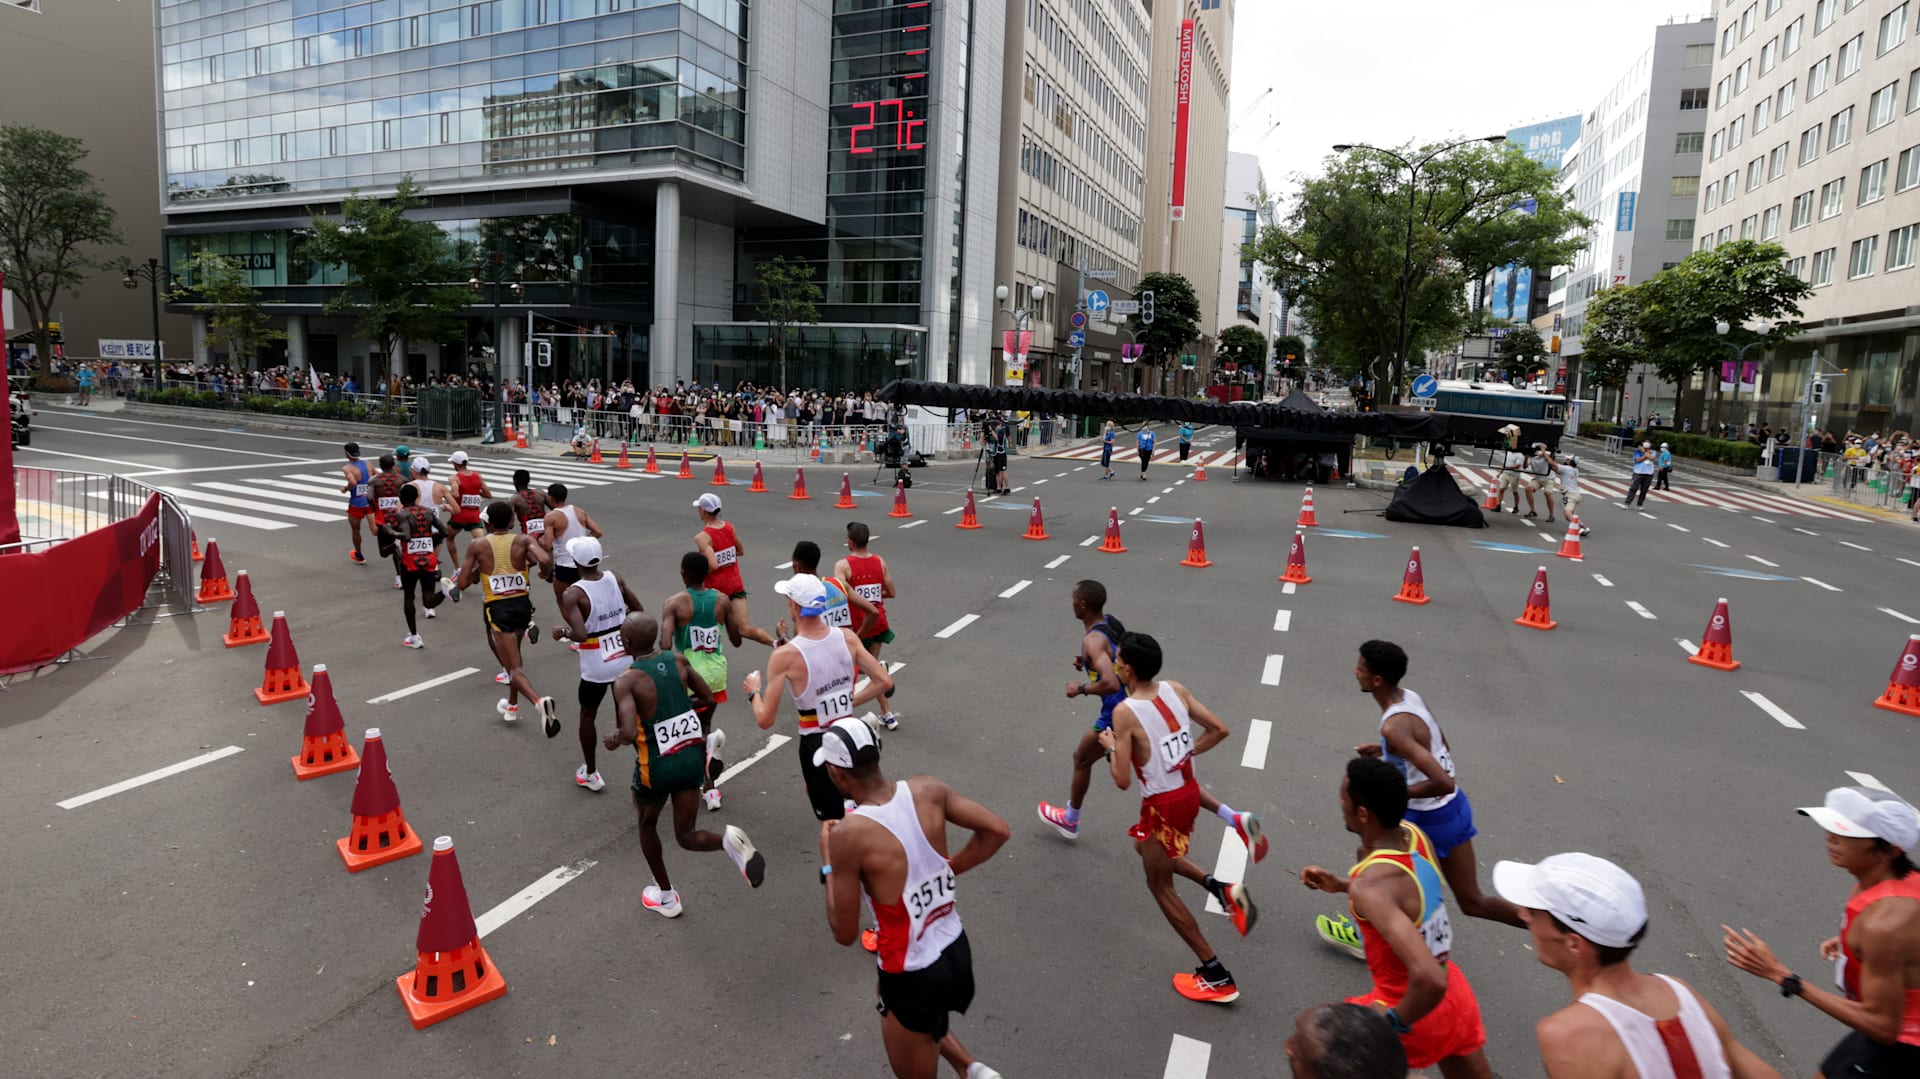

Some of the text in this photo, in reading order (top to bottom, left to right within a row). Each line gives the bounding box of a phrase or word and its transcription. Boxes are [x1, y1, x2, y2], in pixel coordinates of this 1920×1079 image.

[1179, 28, 1192, 104] MITSUKOSHI
[126, 343, 156, 356] 桂和ビ
[409, 539, 431, 550] 2769
[492, 576, 523, 590] 2170
[857, 586, 880, 598] 2893
[824, 608, 848, 626] 1749
[693, 629, 718, 645] 1863
[657, 715, 700, 744] 3423
